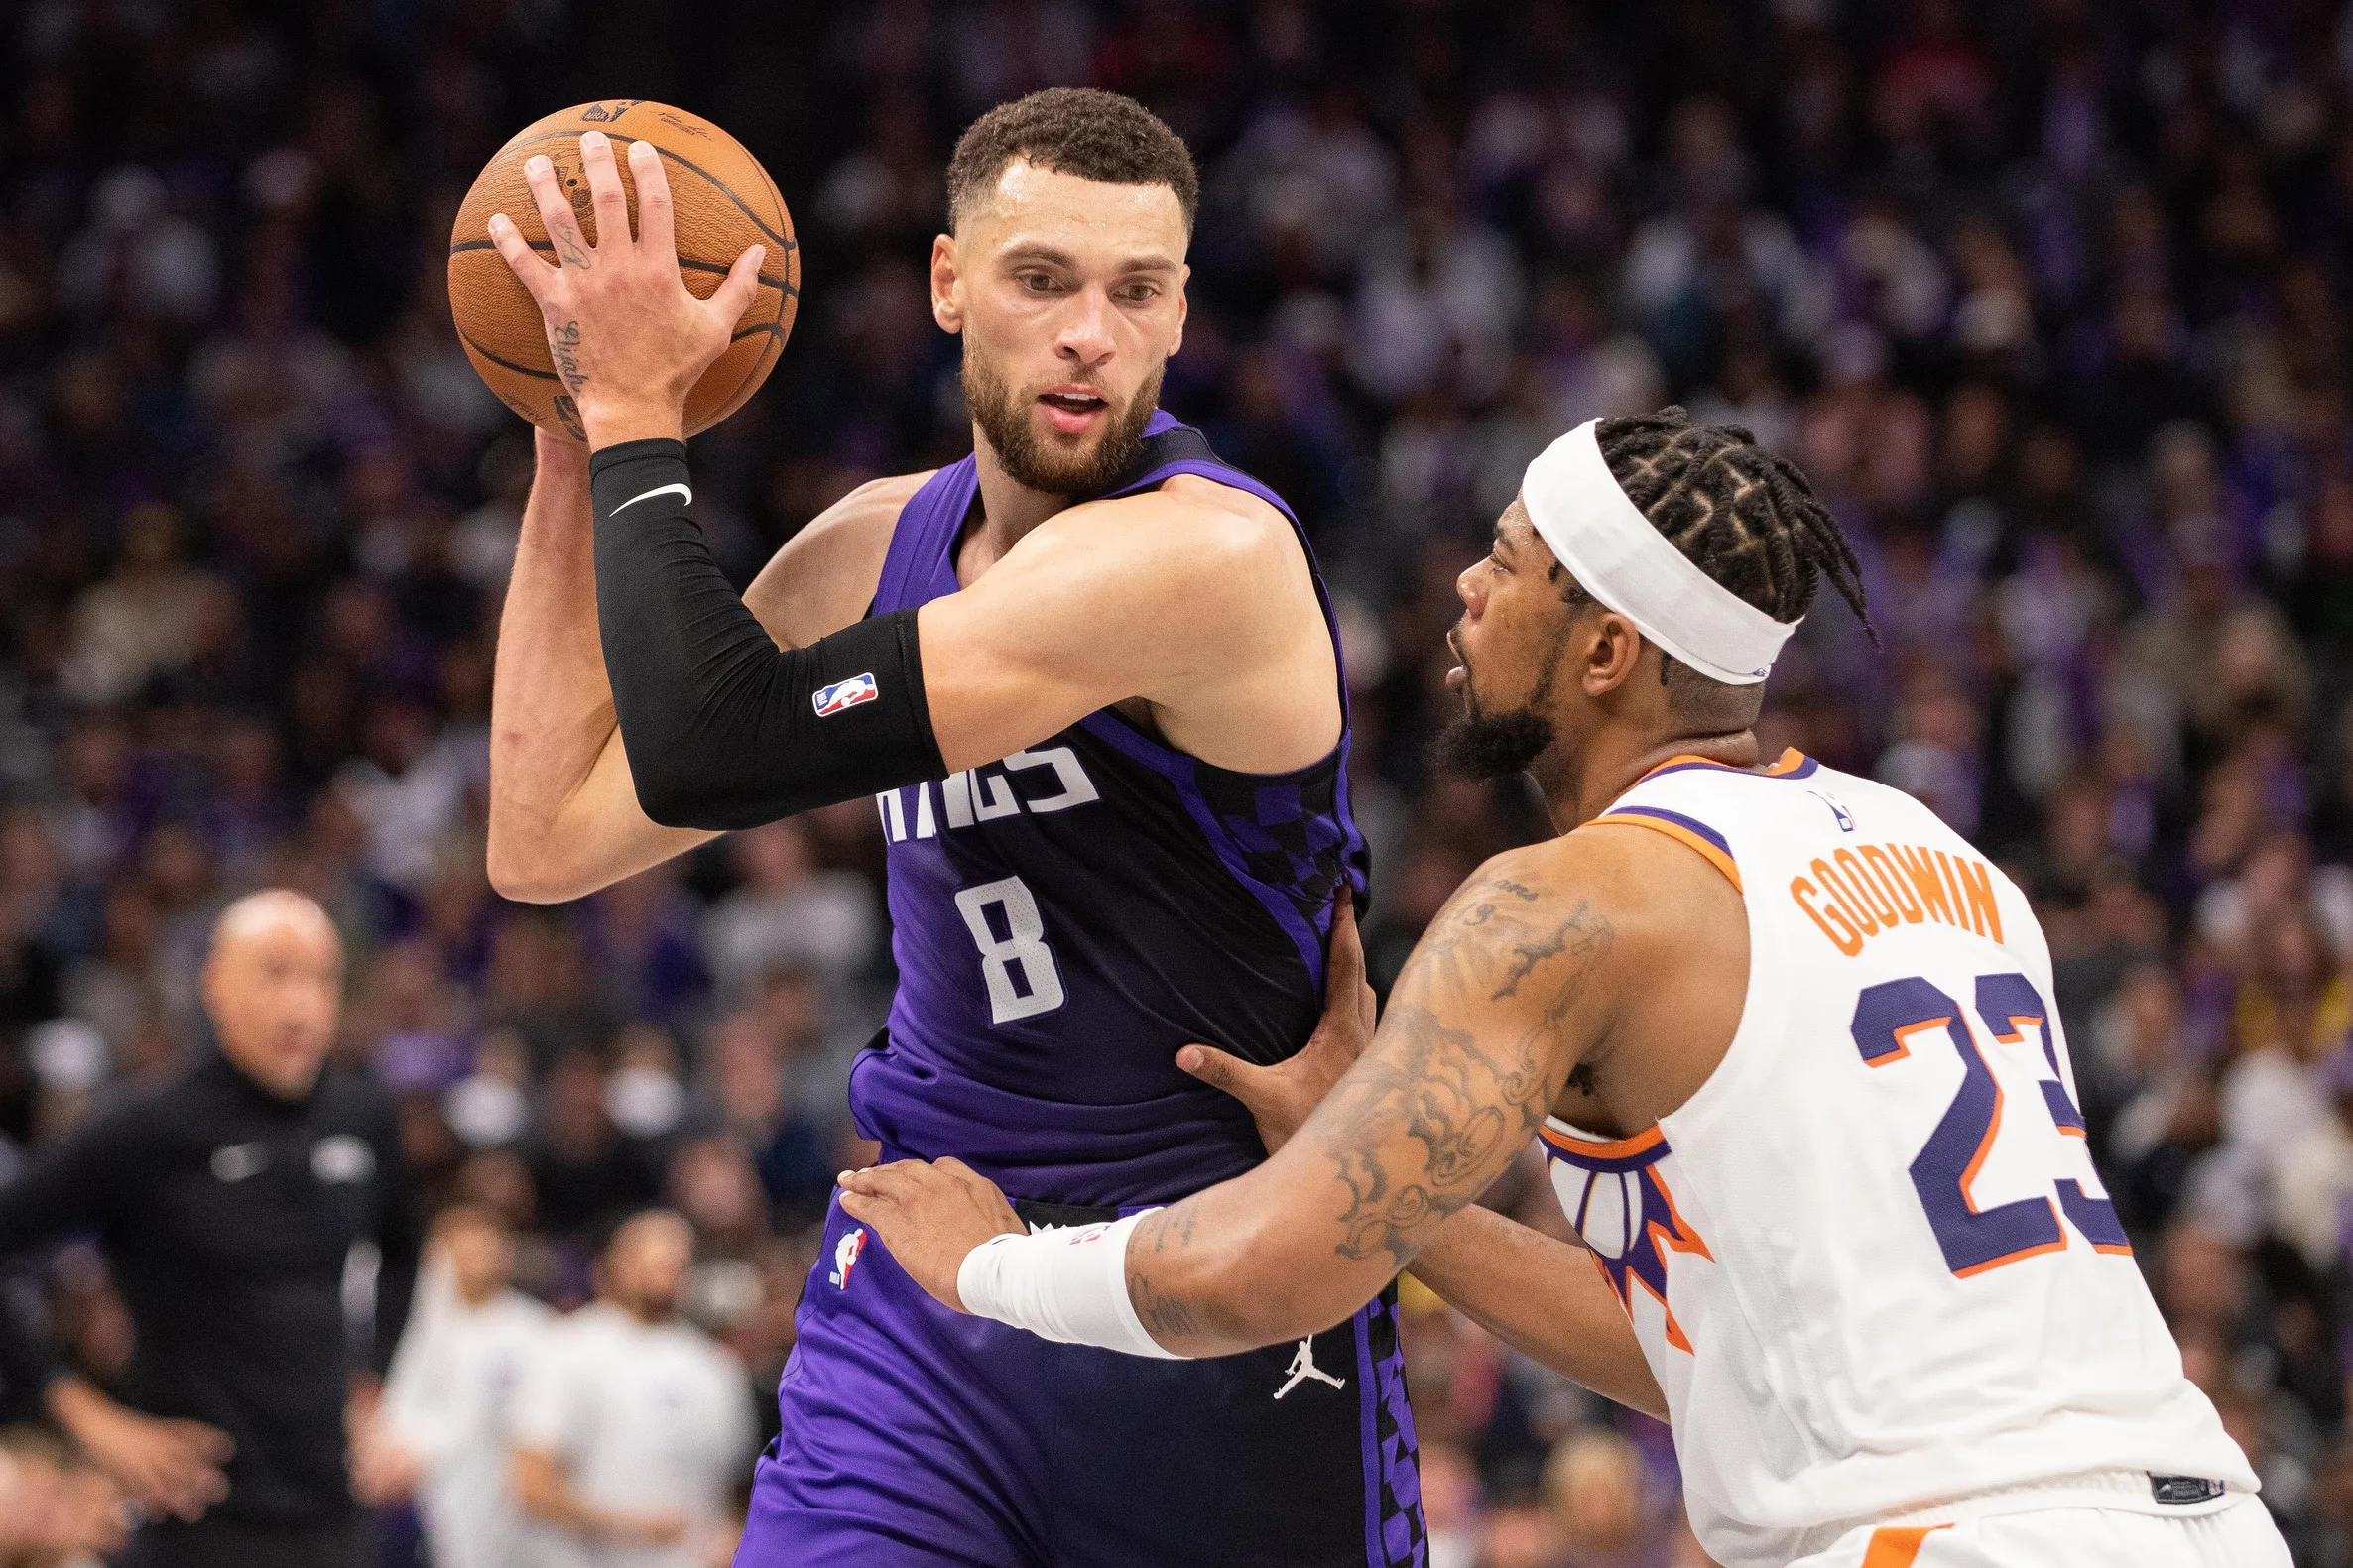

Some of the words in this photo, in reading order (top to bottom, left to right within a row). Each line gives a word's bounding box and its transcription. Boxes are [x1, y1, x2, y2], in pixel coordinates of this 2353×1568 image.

[955, 876, 1064, 1024] 8
[1790, 843, 2004, 957] GOODWIN
[1851, 973, 2133, 1279] 23
